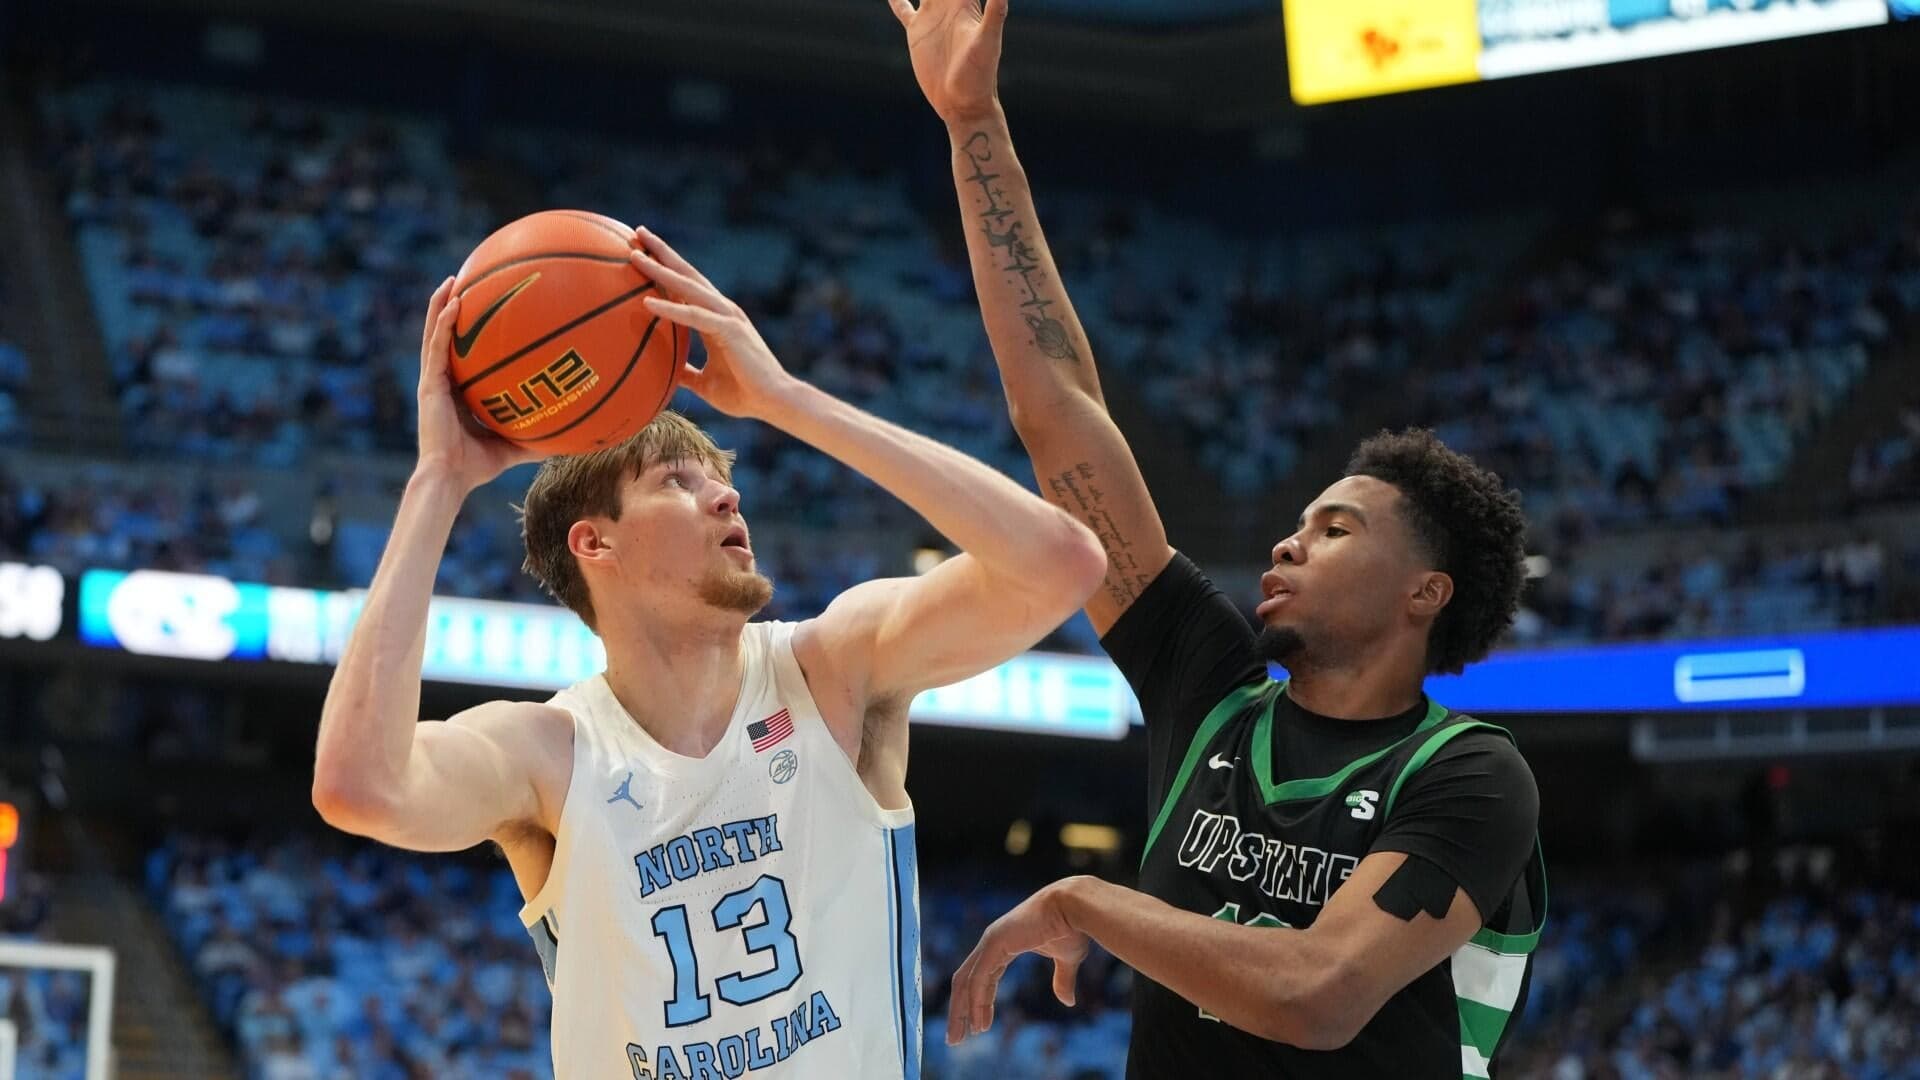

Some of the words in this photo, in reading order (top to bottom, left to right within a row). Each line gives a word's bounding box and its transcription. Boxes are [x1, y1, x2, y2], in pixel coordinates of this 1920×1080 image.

[480, 347, 594, 425] ELITE
[1351, 790, 1379, 820] S
[634, 813, 783, 898] NORTH
[650, 873, 803, 1028] 13
[626, 990, 841, 1080] CAROLINA
